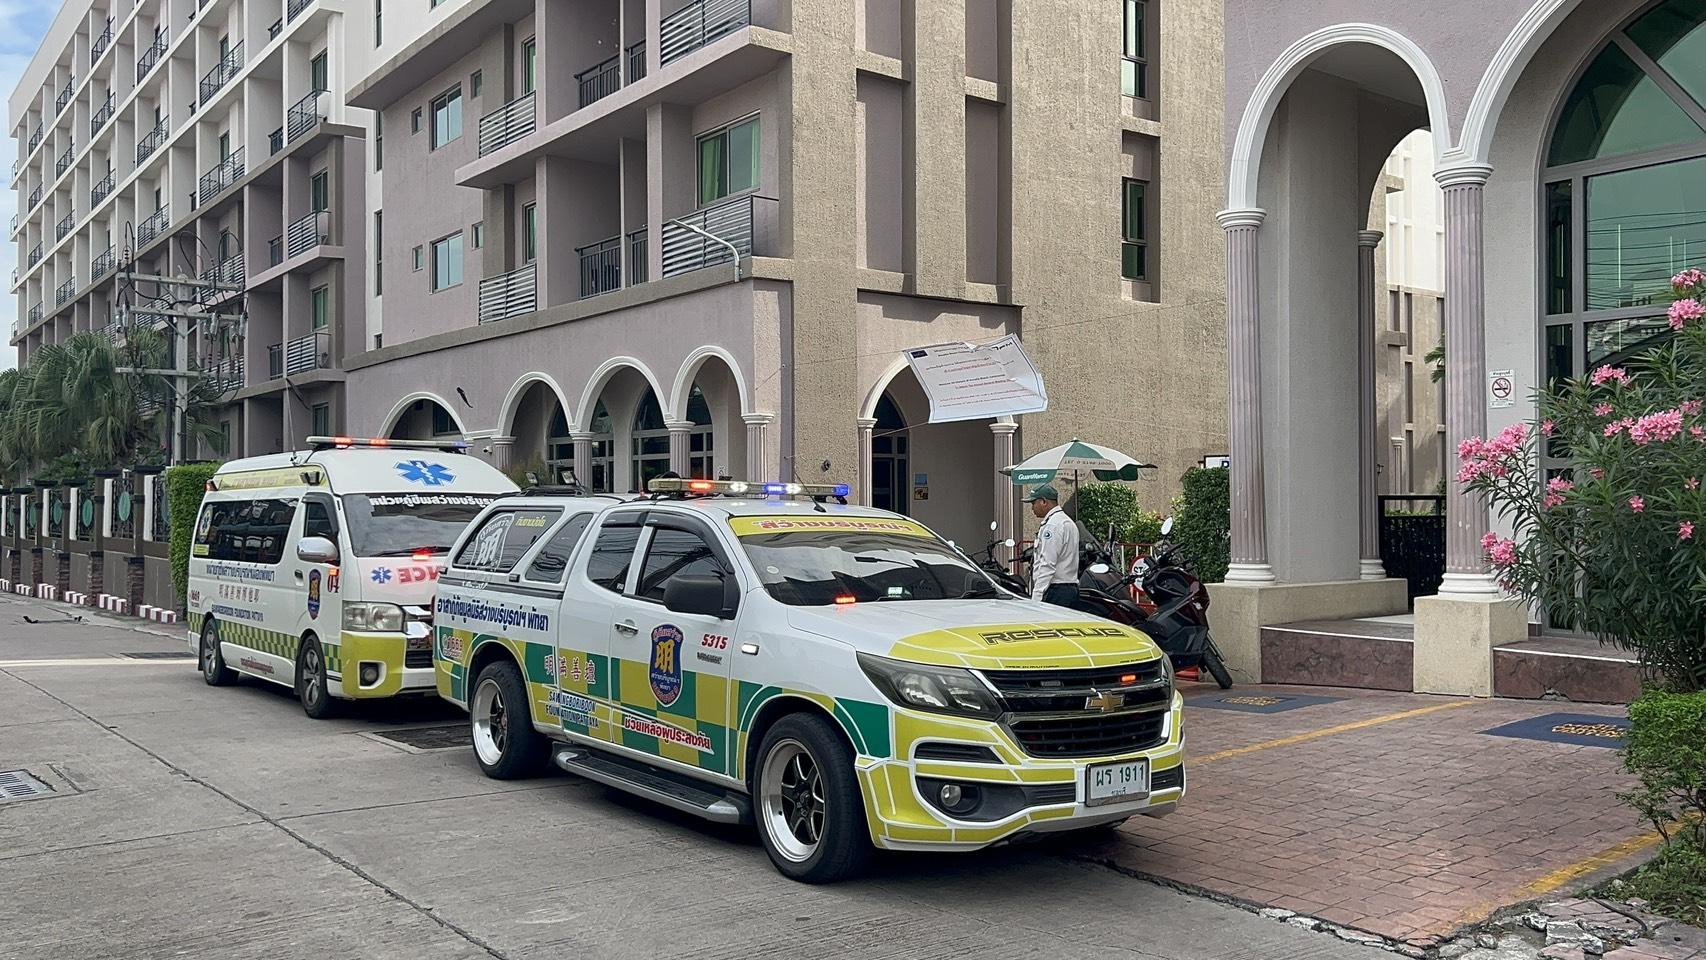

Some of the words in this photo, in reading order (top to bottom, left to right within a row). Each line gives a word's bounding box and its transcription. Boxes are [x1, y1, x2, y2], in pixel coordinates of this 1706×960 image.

[701, 633, 728, 650] 5315
[979, 628, 1130, 645] RESCUE
[549, 691, 596, 712] SAWNGBORIBOON
[545, 704, 577, 722] FOUNATION
[1096, 769, 1113, 786] ผร
[1119, 764, 1144, 783] 1911
